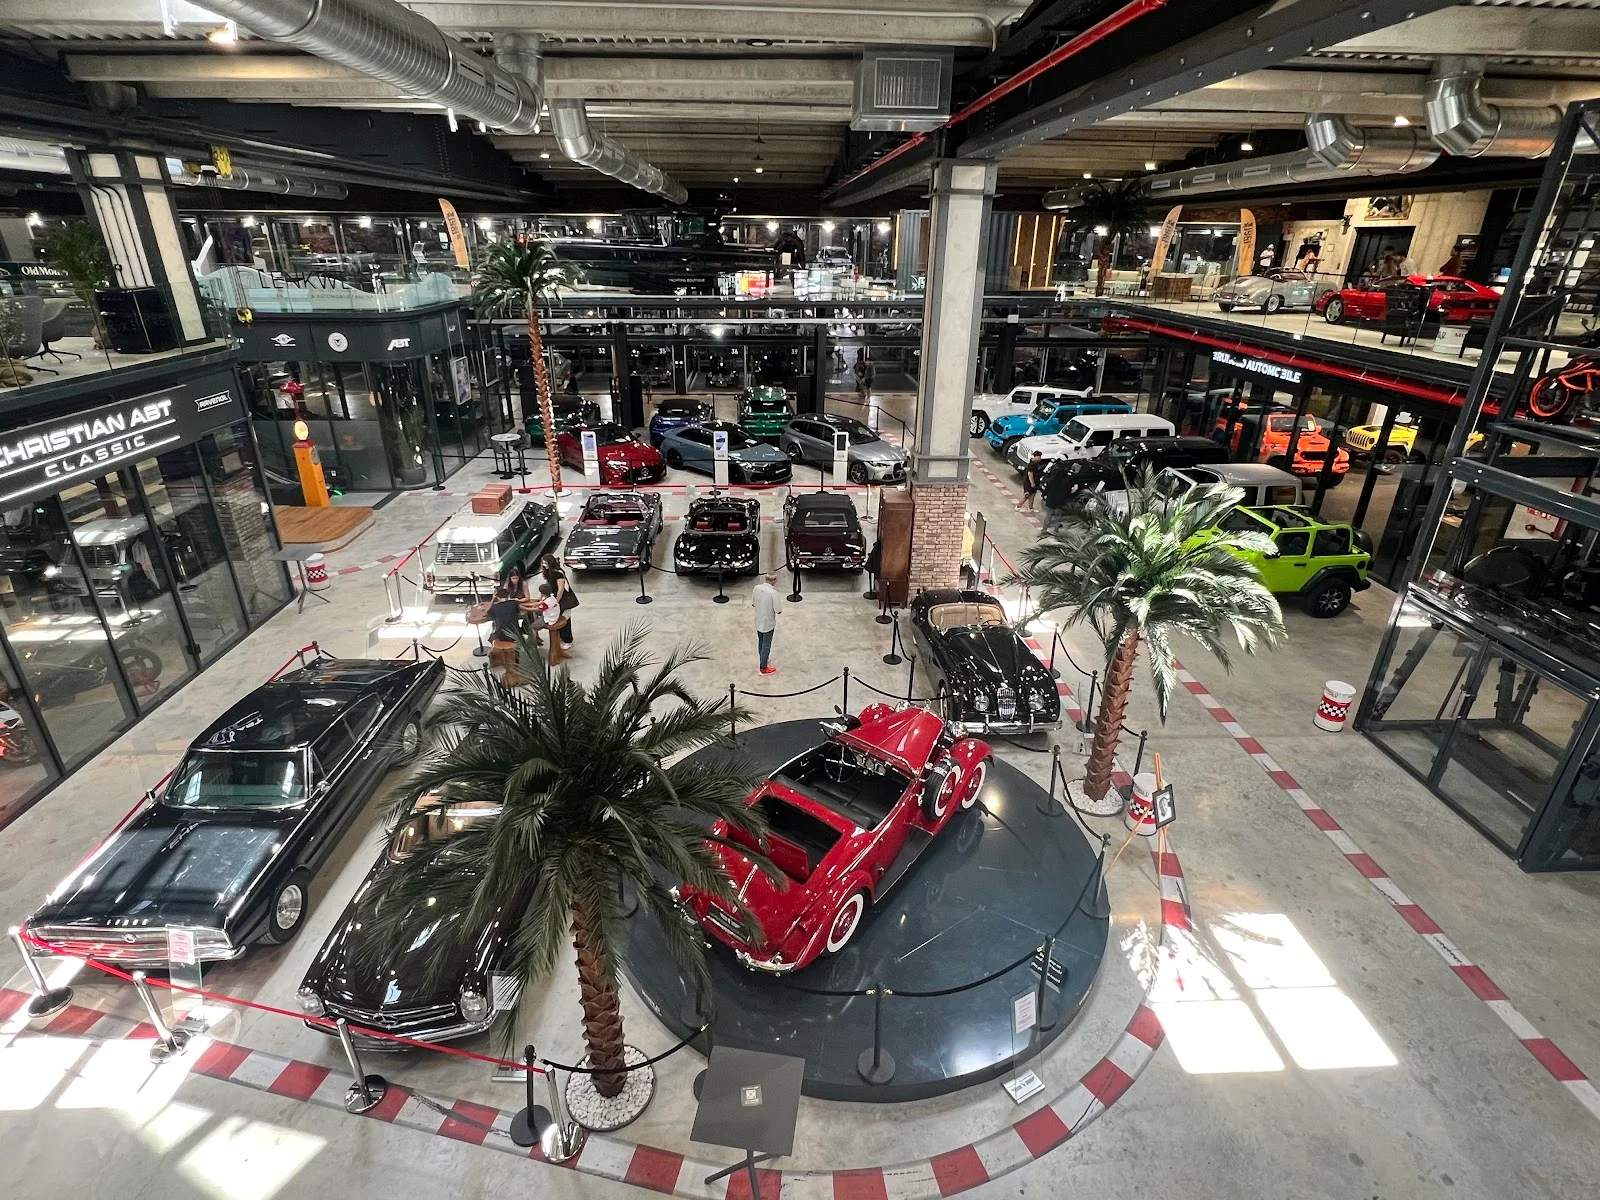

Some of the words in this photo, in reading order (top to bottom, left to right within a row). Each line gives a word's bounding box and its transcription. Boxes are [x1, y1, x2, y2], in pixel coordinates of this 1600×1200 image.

[387, 338, 410, 351] ABT
[130, 399, 172, 427] ABT
[45, 435, 146, 477] CLASSIC
